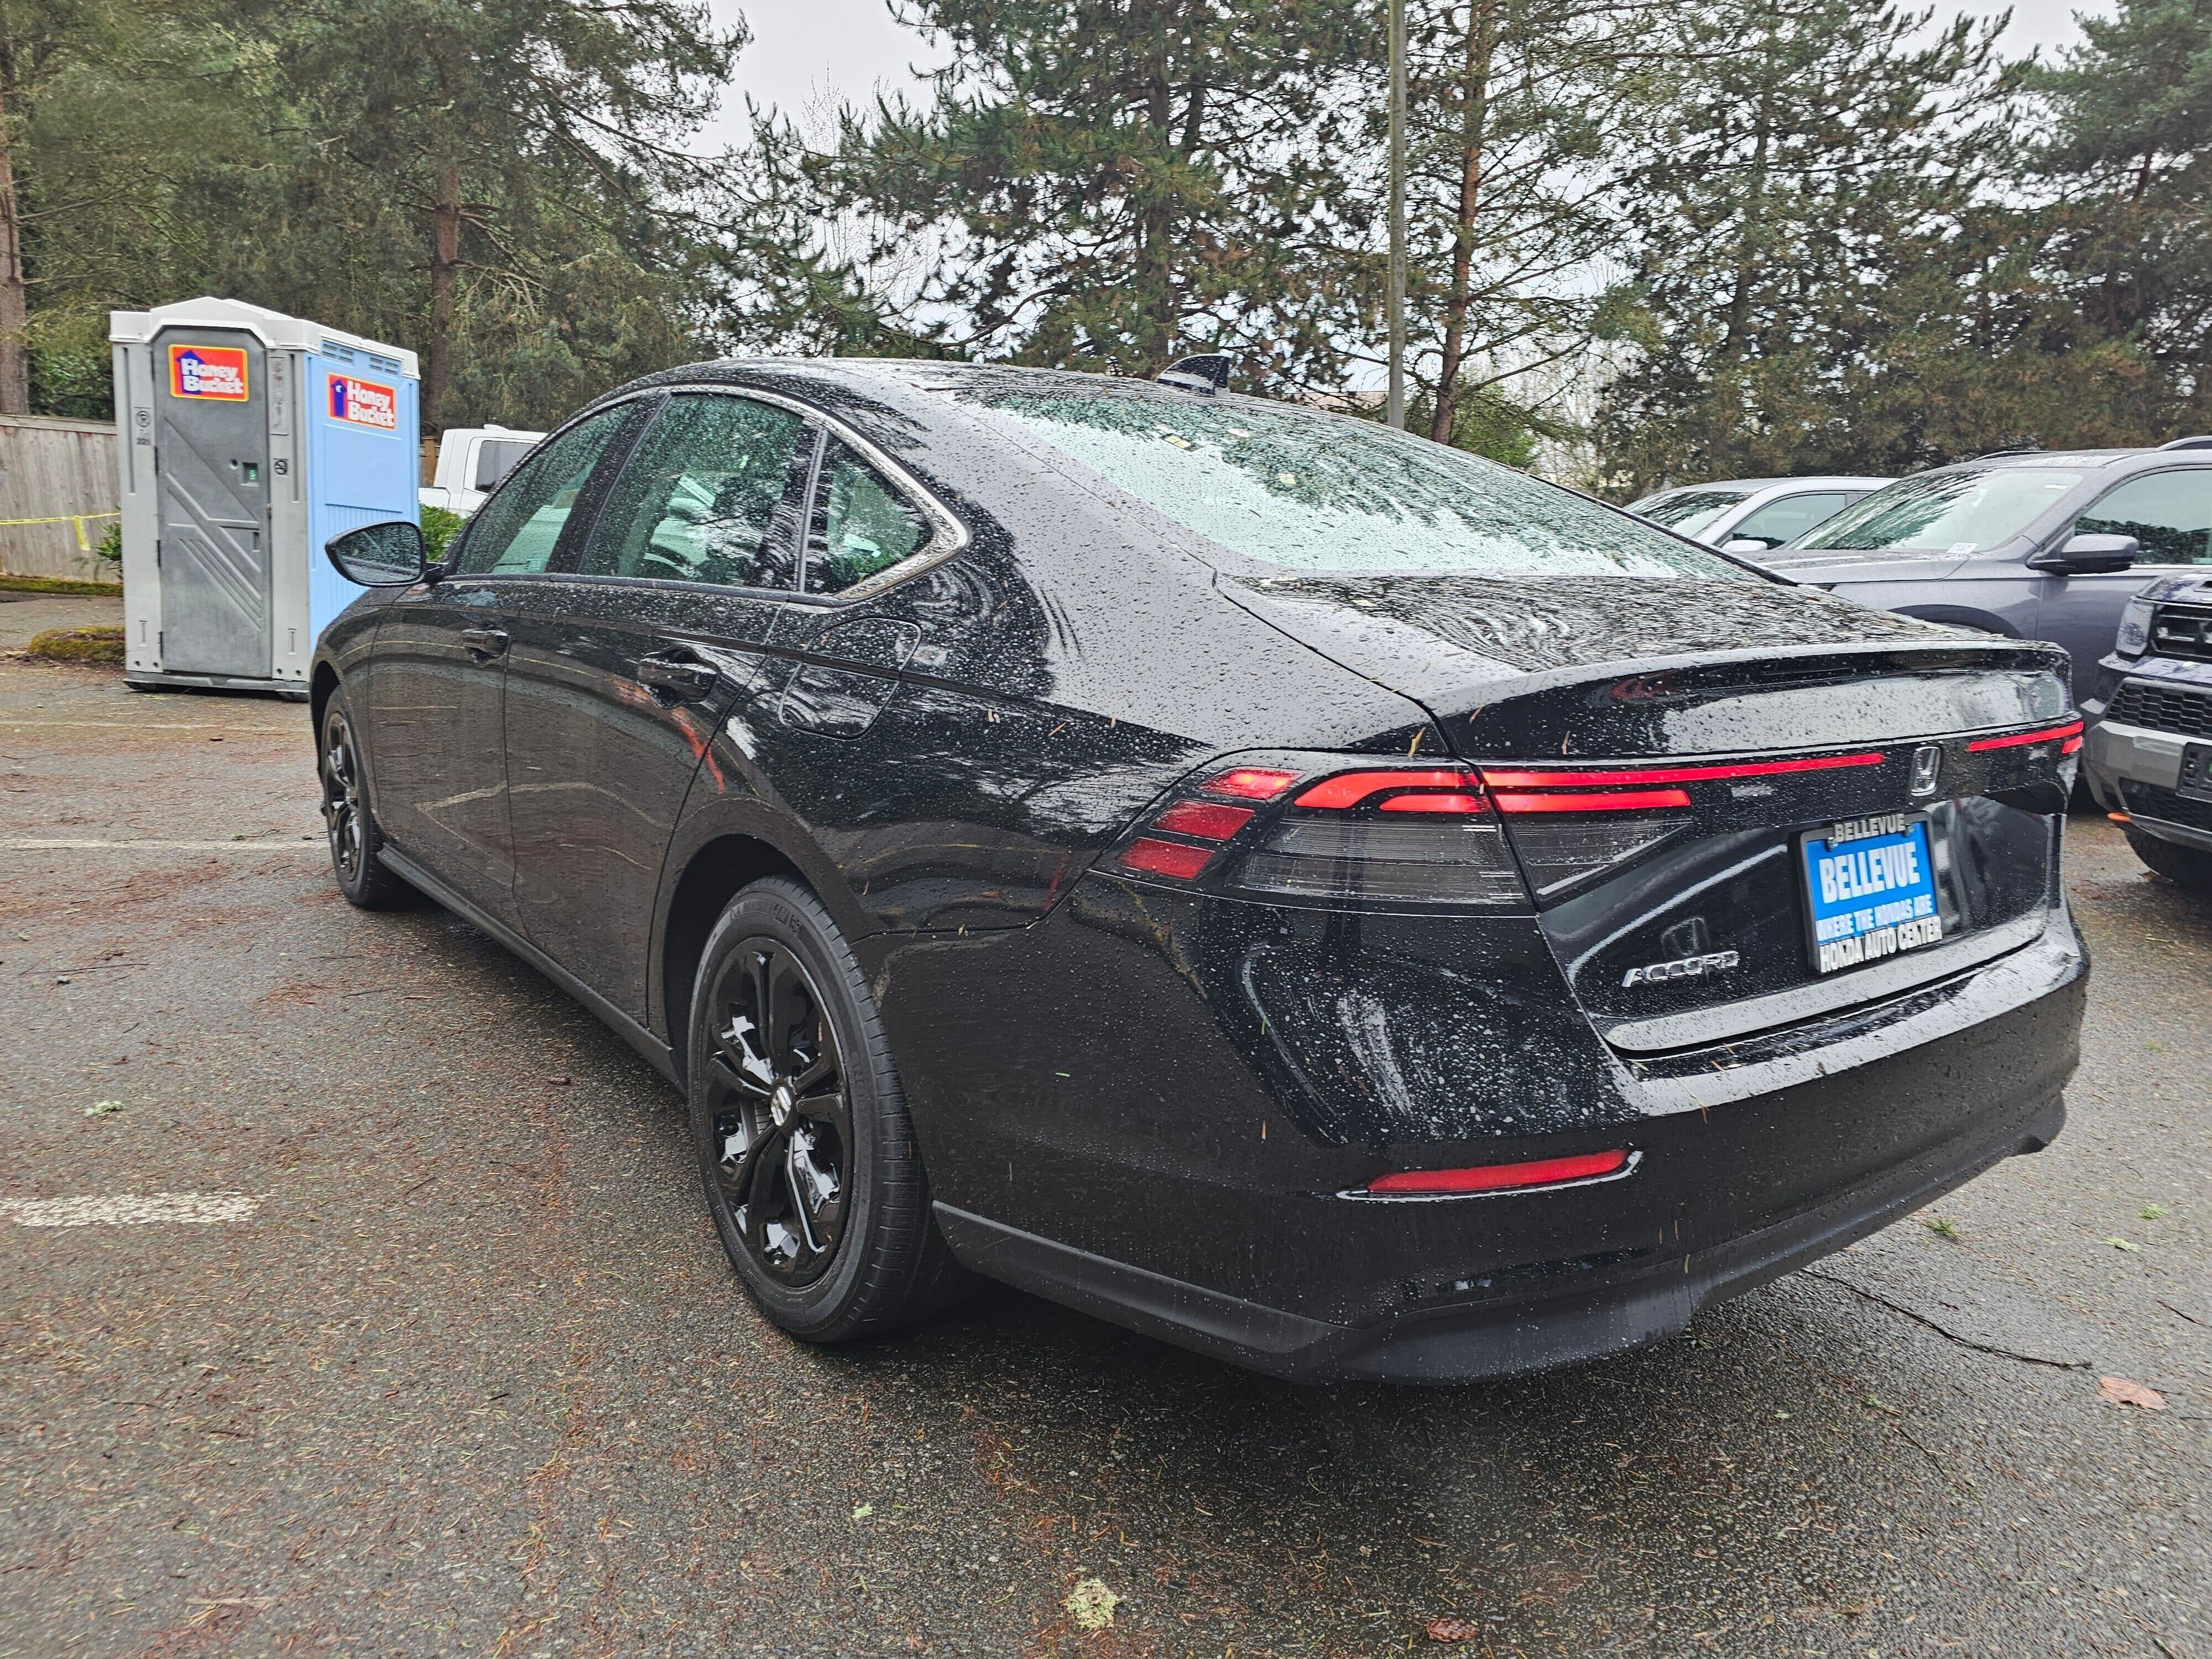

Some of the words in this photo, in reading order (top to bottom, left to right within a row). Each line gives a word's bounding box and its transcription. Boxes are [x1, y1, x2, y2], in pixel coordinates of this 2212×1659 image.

[180, 358, 239, 382] Honey
[182, 375, 244, 394] Bucket
[346, 380, 392, 412] Honey
[347, 401, 395, 427] Bucket
[1833, 813, 1906, 843] BELLEVUE
[1819, 842, 1921, 904] BELLEVUE
[1815, 913, 1855, 941] WHERE
[1854, 908, 1875, 932] THE
[1819, 937, 1865, 973] HONDA
[1864, 927, 1897, 960] AUTO
[1897, 916, 1943, 950] CENTER
[1621, 950, 1740, 988] ACCORD
